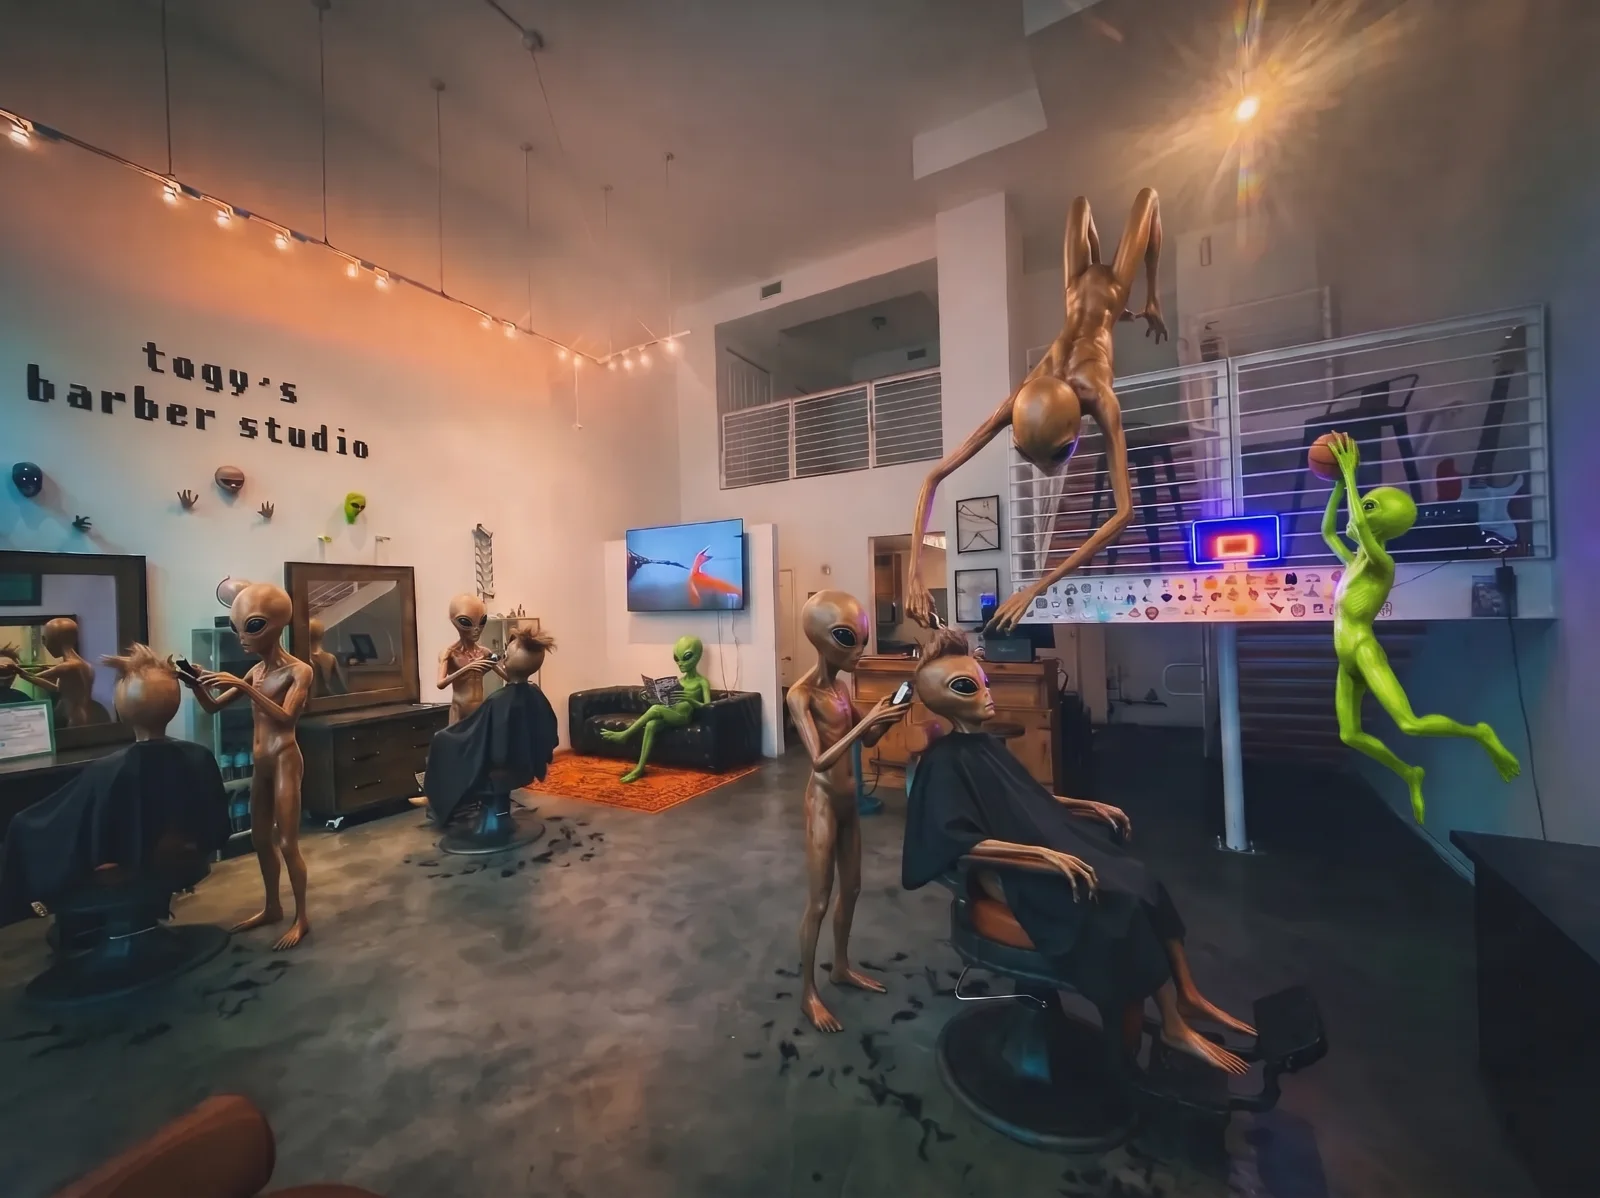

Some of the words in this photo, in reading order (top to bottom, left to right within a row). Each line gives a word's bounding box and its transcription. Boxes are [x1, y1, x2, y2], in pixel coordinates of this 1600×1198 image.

[27, 363, 216, 431] barber
[239, 416, 369, 459] studio
[142, 341, 298, 404] togy's
